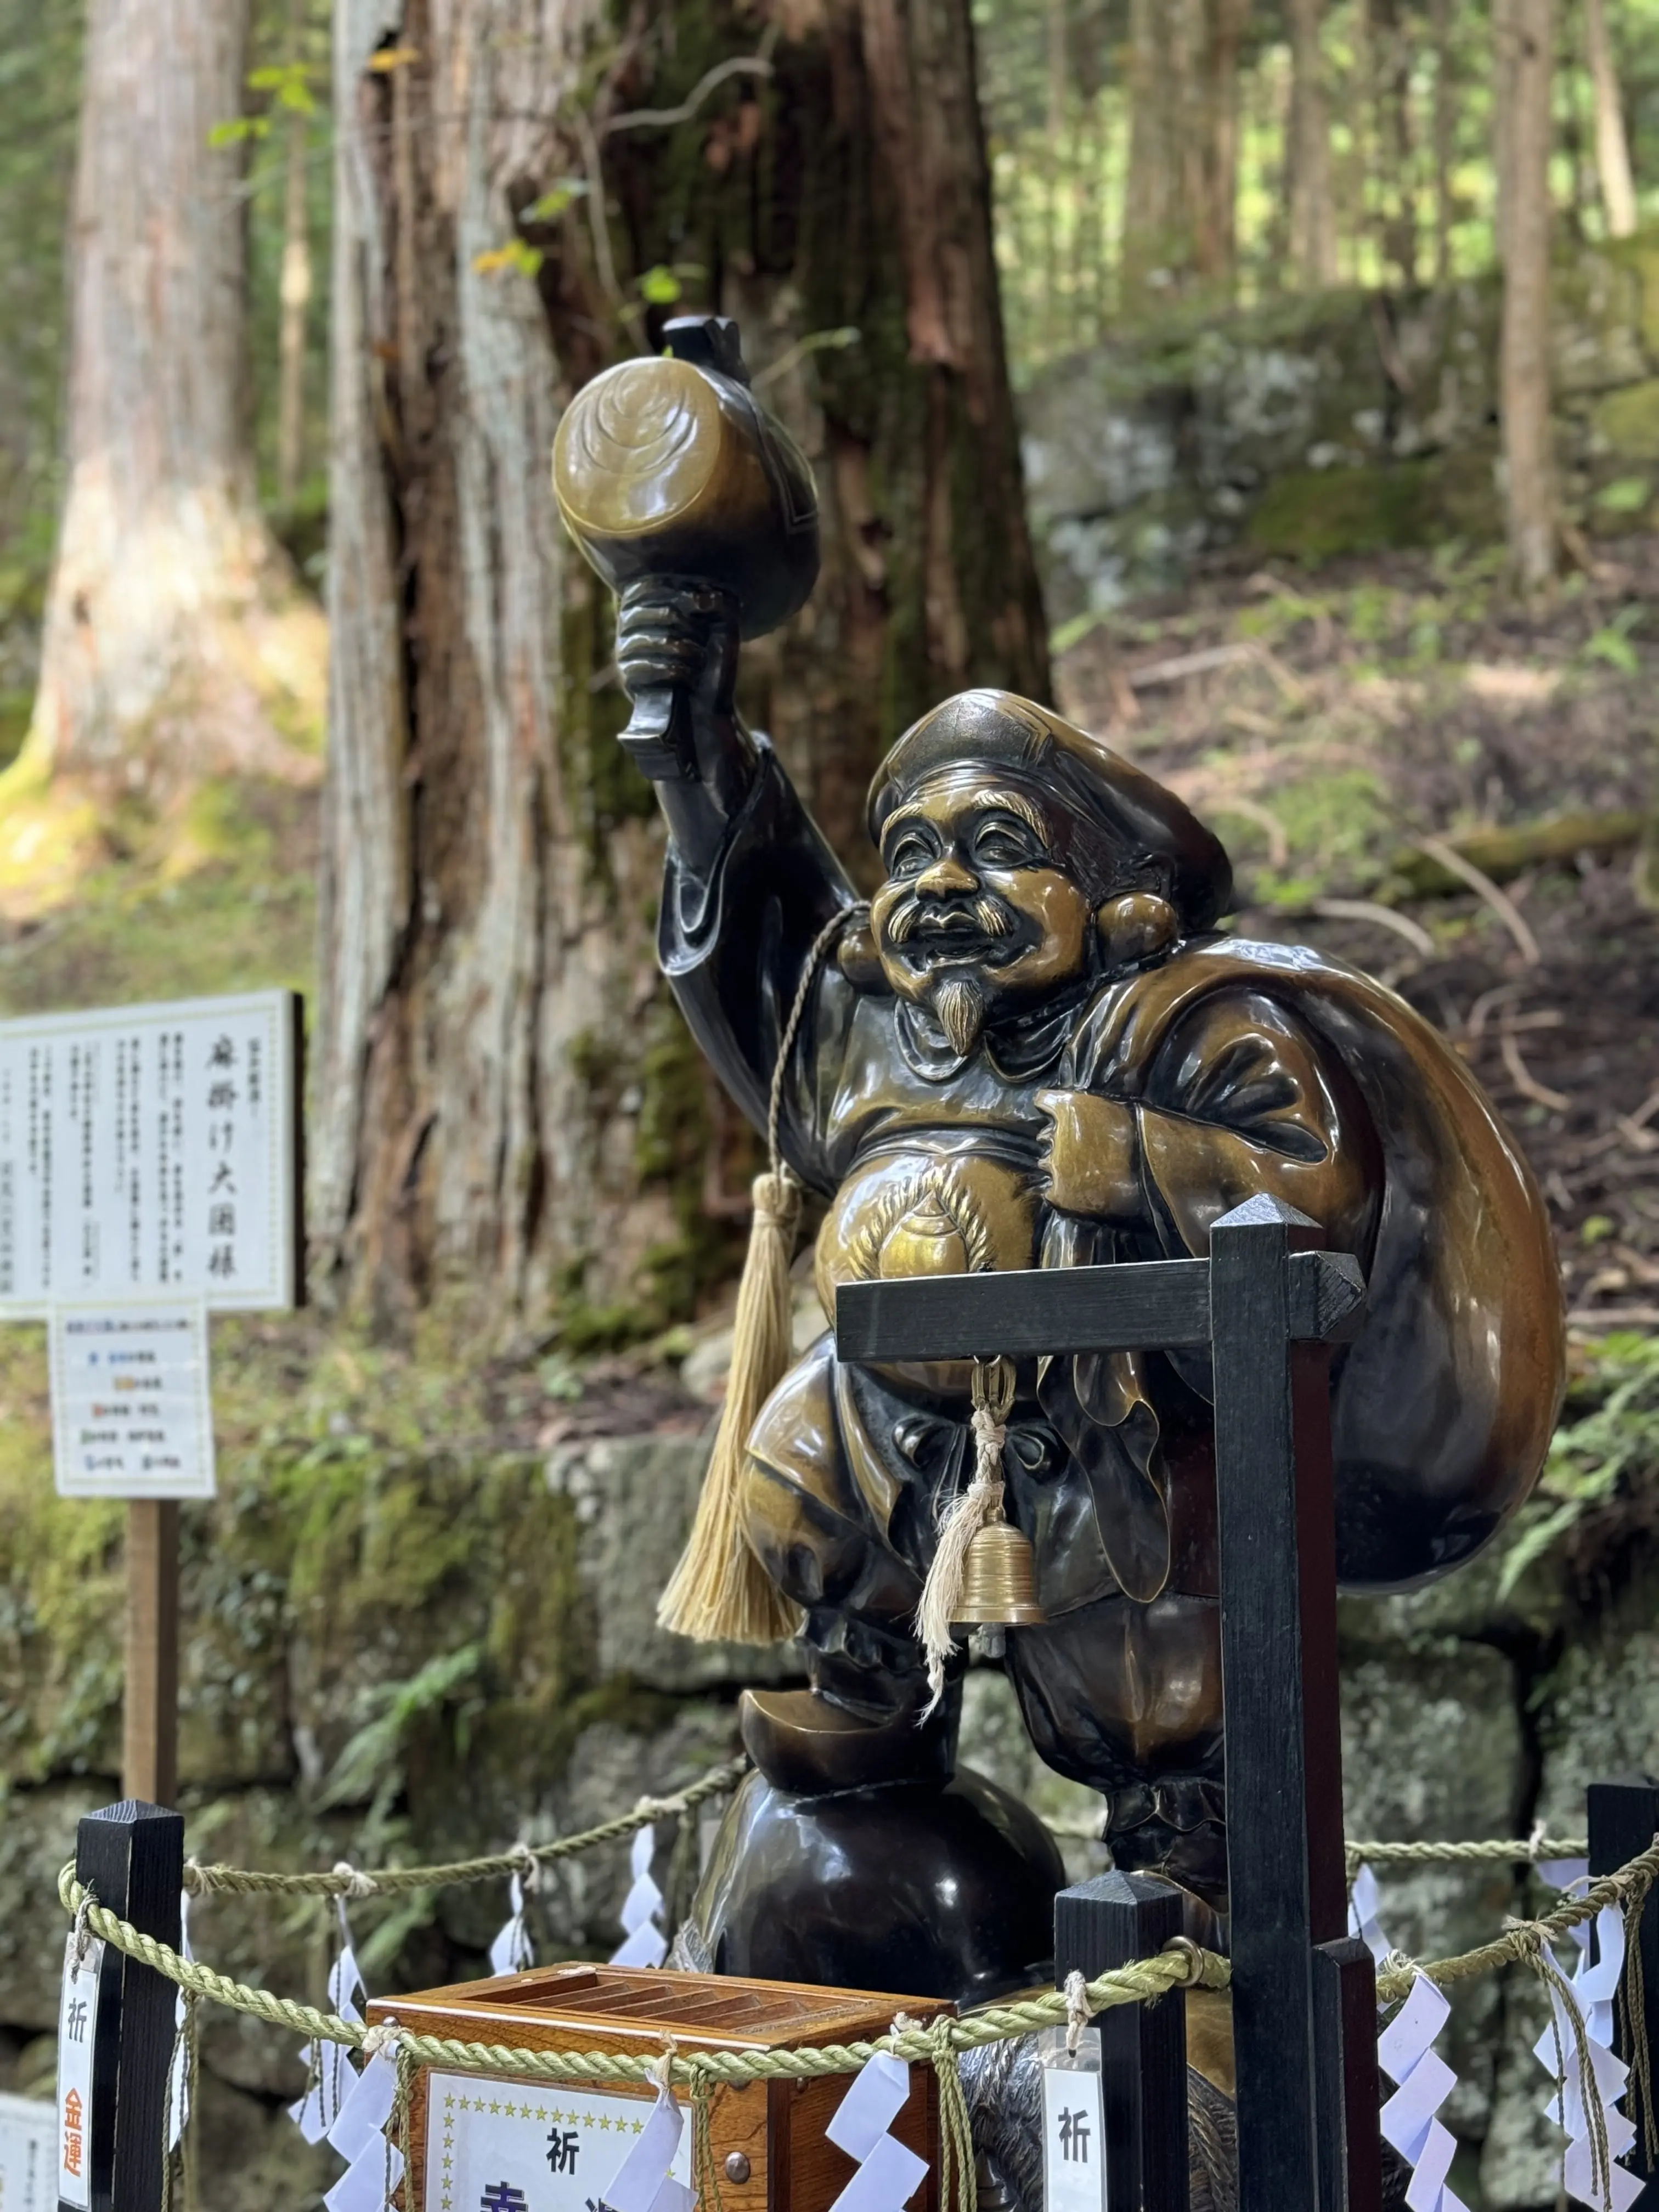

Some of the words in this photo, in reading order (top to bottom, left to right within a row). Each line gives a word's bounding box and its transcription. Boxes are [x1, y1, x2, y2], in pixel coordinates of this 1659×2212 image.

[68, 1996, 87, 2044] 祈
[64, 2087, 83, 2178] 金運
[545, 2127, 580, 2175] 祈
[1057, 2106, 1091, 2163] 祈
